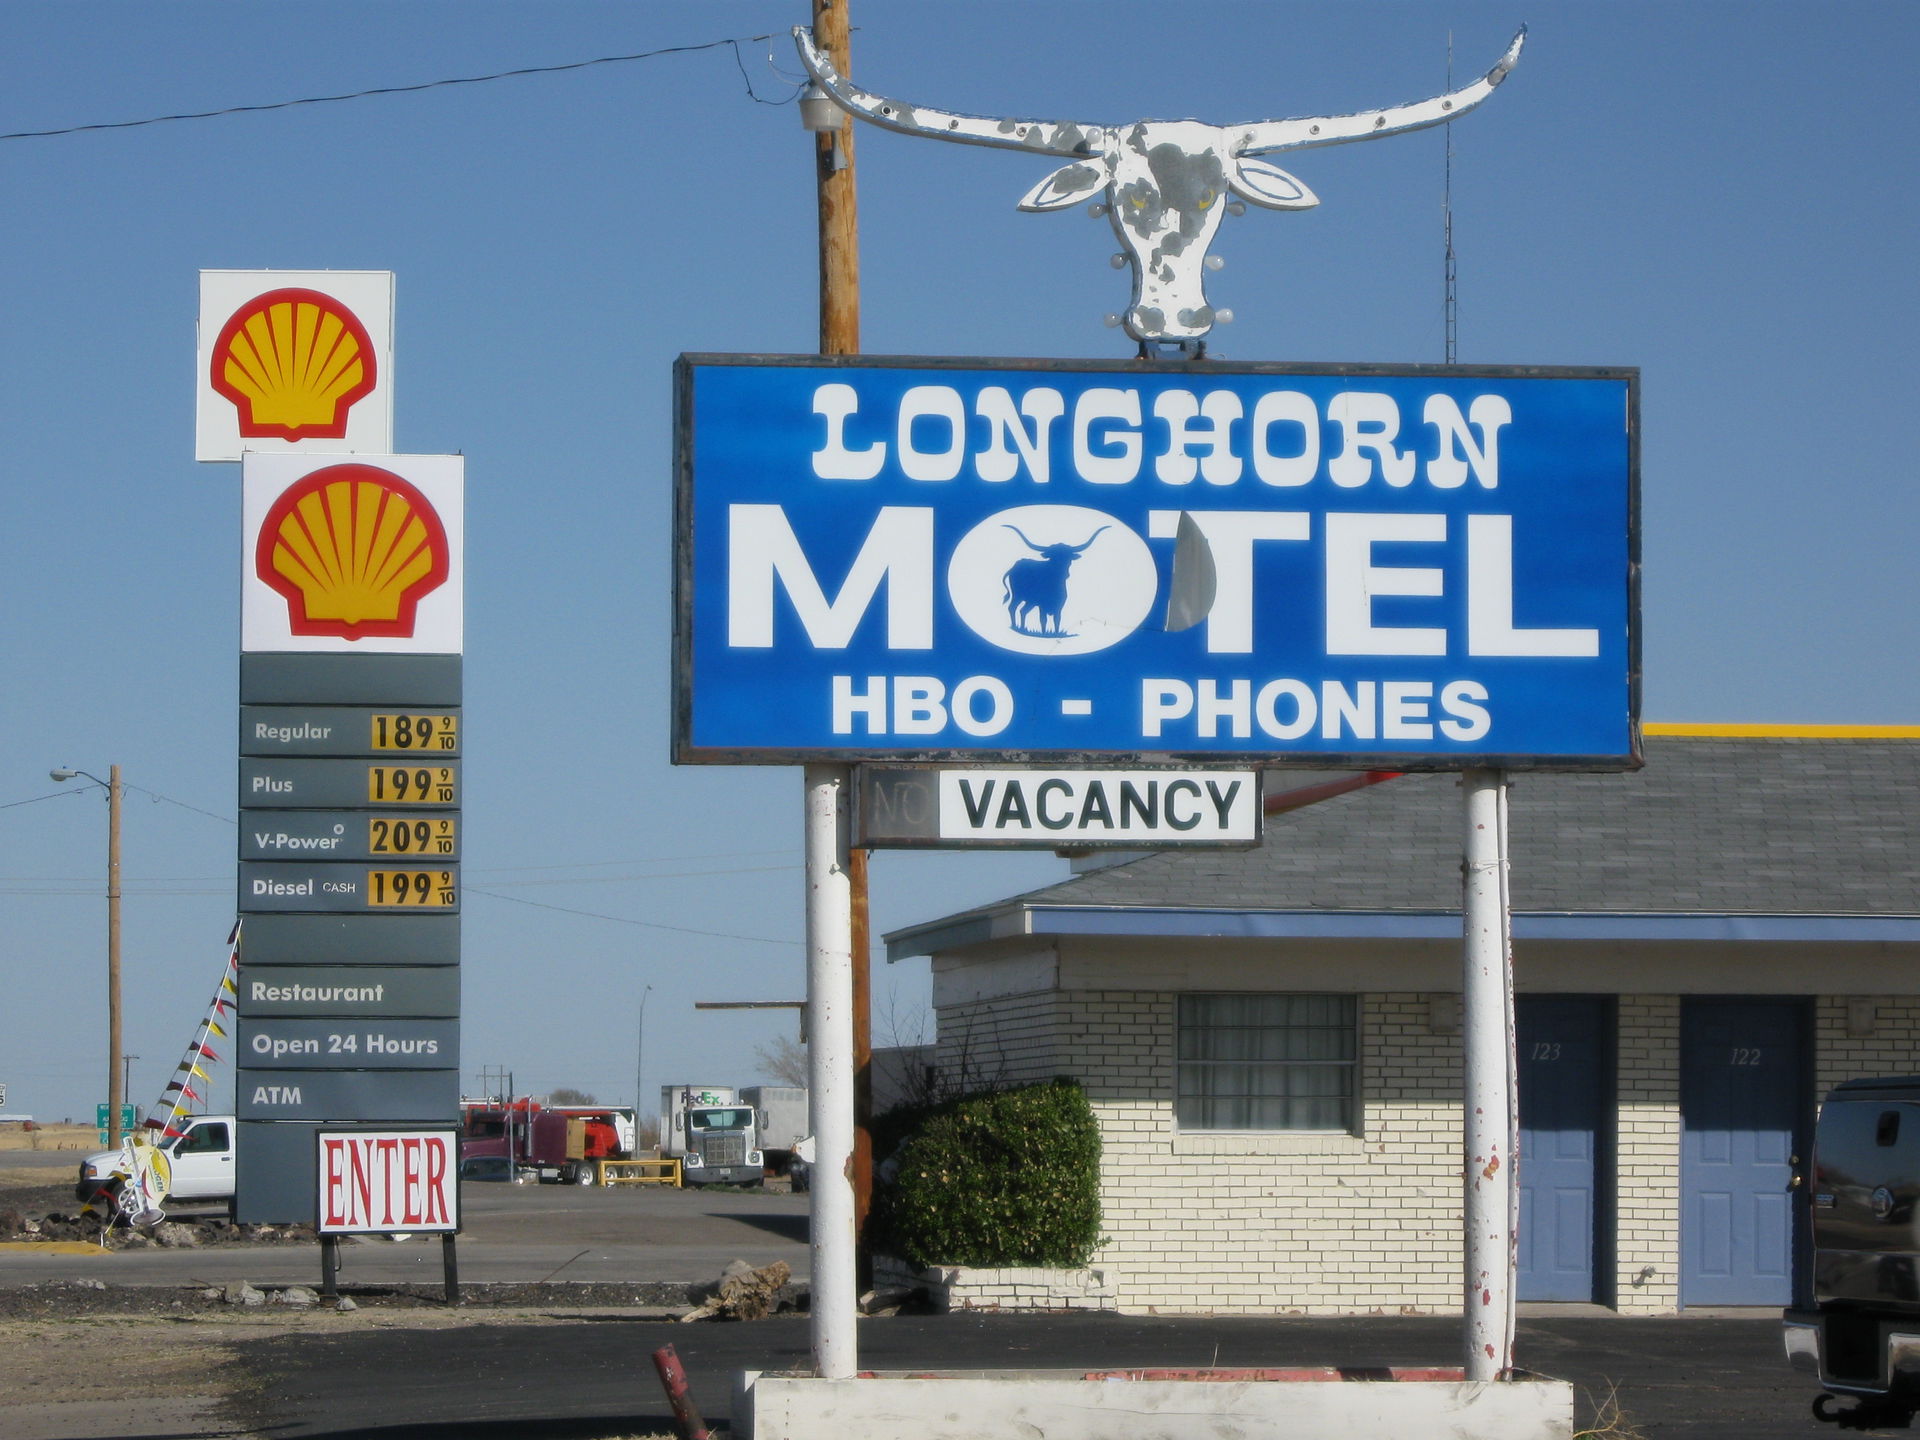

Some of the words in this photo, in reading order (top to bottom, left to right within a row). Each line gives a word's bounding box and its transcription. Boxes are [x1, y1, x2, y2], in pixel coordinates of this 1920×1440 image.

[812, 383, 1512, 491] LONGHORN
[728, 503, 1600, 658] MOTEL
[832, 676, 1014, 737] HBO
[1141, 678, 1491, 741] PHONES
[255, 722, 332, 743] Regular
[252, 776, 293, 793] Plus
[958, 778, 1241, 831] VACANCY
[255, 832, 339, 850] V-Power
[253, 879, 314, 896] Diesel
[322, 882, 356, 894] CASH
[251, 981, 384, 1002] Restaurant
[252, 1033, 319, 1059] Open
[327, 1034, 358, 1054] 24
[366, 1034, 439, 1054] Hours
[1531, 1042, 1561, 1061] 123
[1730, 1047, 1761, 1066] 122
[252, 1086, 302, 1105] ATM
[680, 1091, 721, 1105] FedEx
[324, 1137, 450, 1228] ENTER
